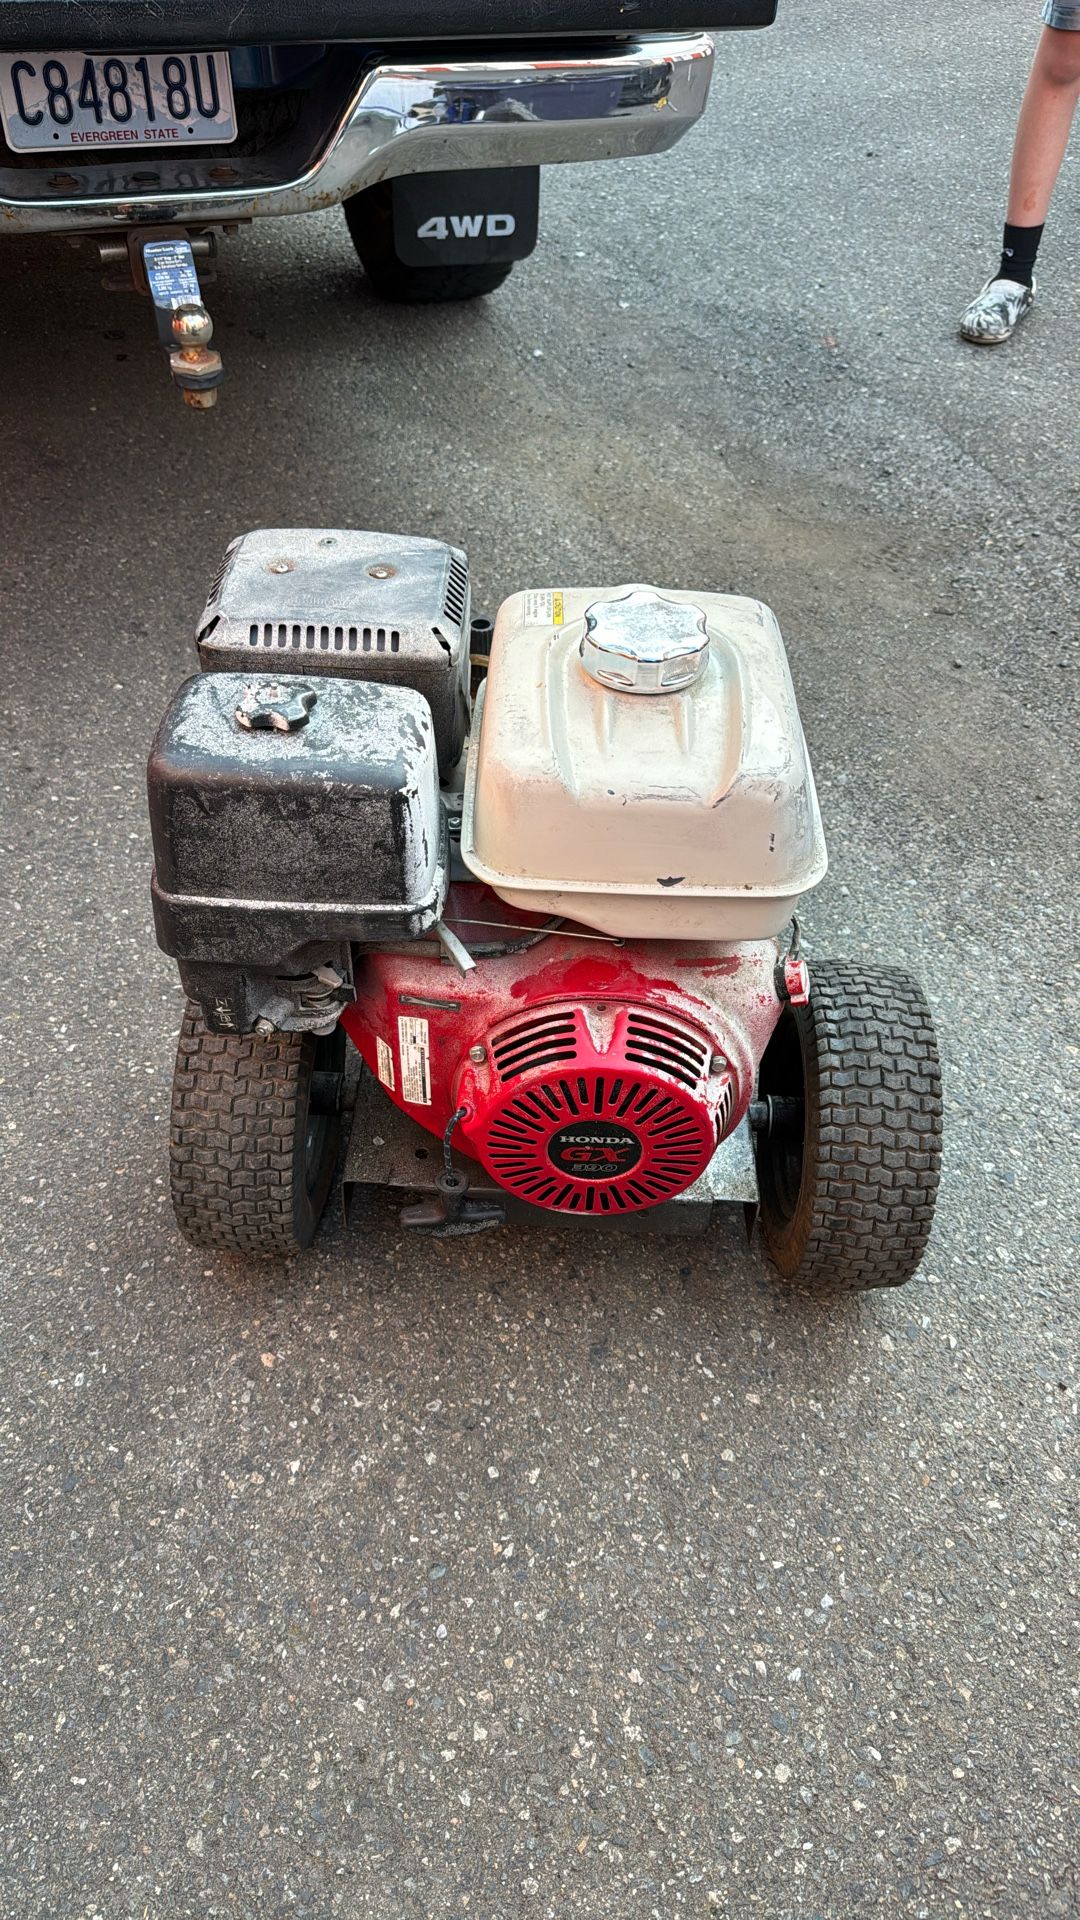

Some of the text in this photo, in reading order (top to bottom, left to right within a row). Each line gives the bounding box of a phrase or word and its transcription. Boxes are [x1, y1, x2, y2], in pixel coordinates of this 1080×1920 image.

[10, 55, 221, 126] C84818U
[70, 128, 179, 142] EVERGREEN STATE
[417, 214, 516, 239] 4WD
[560, 1135, 635, 1145] HONDA
[560, 1146, 631, 1162] GX
